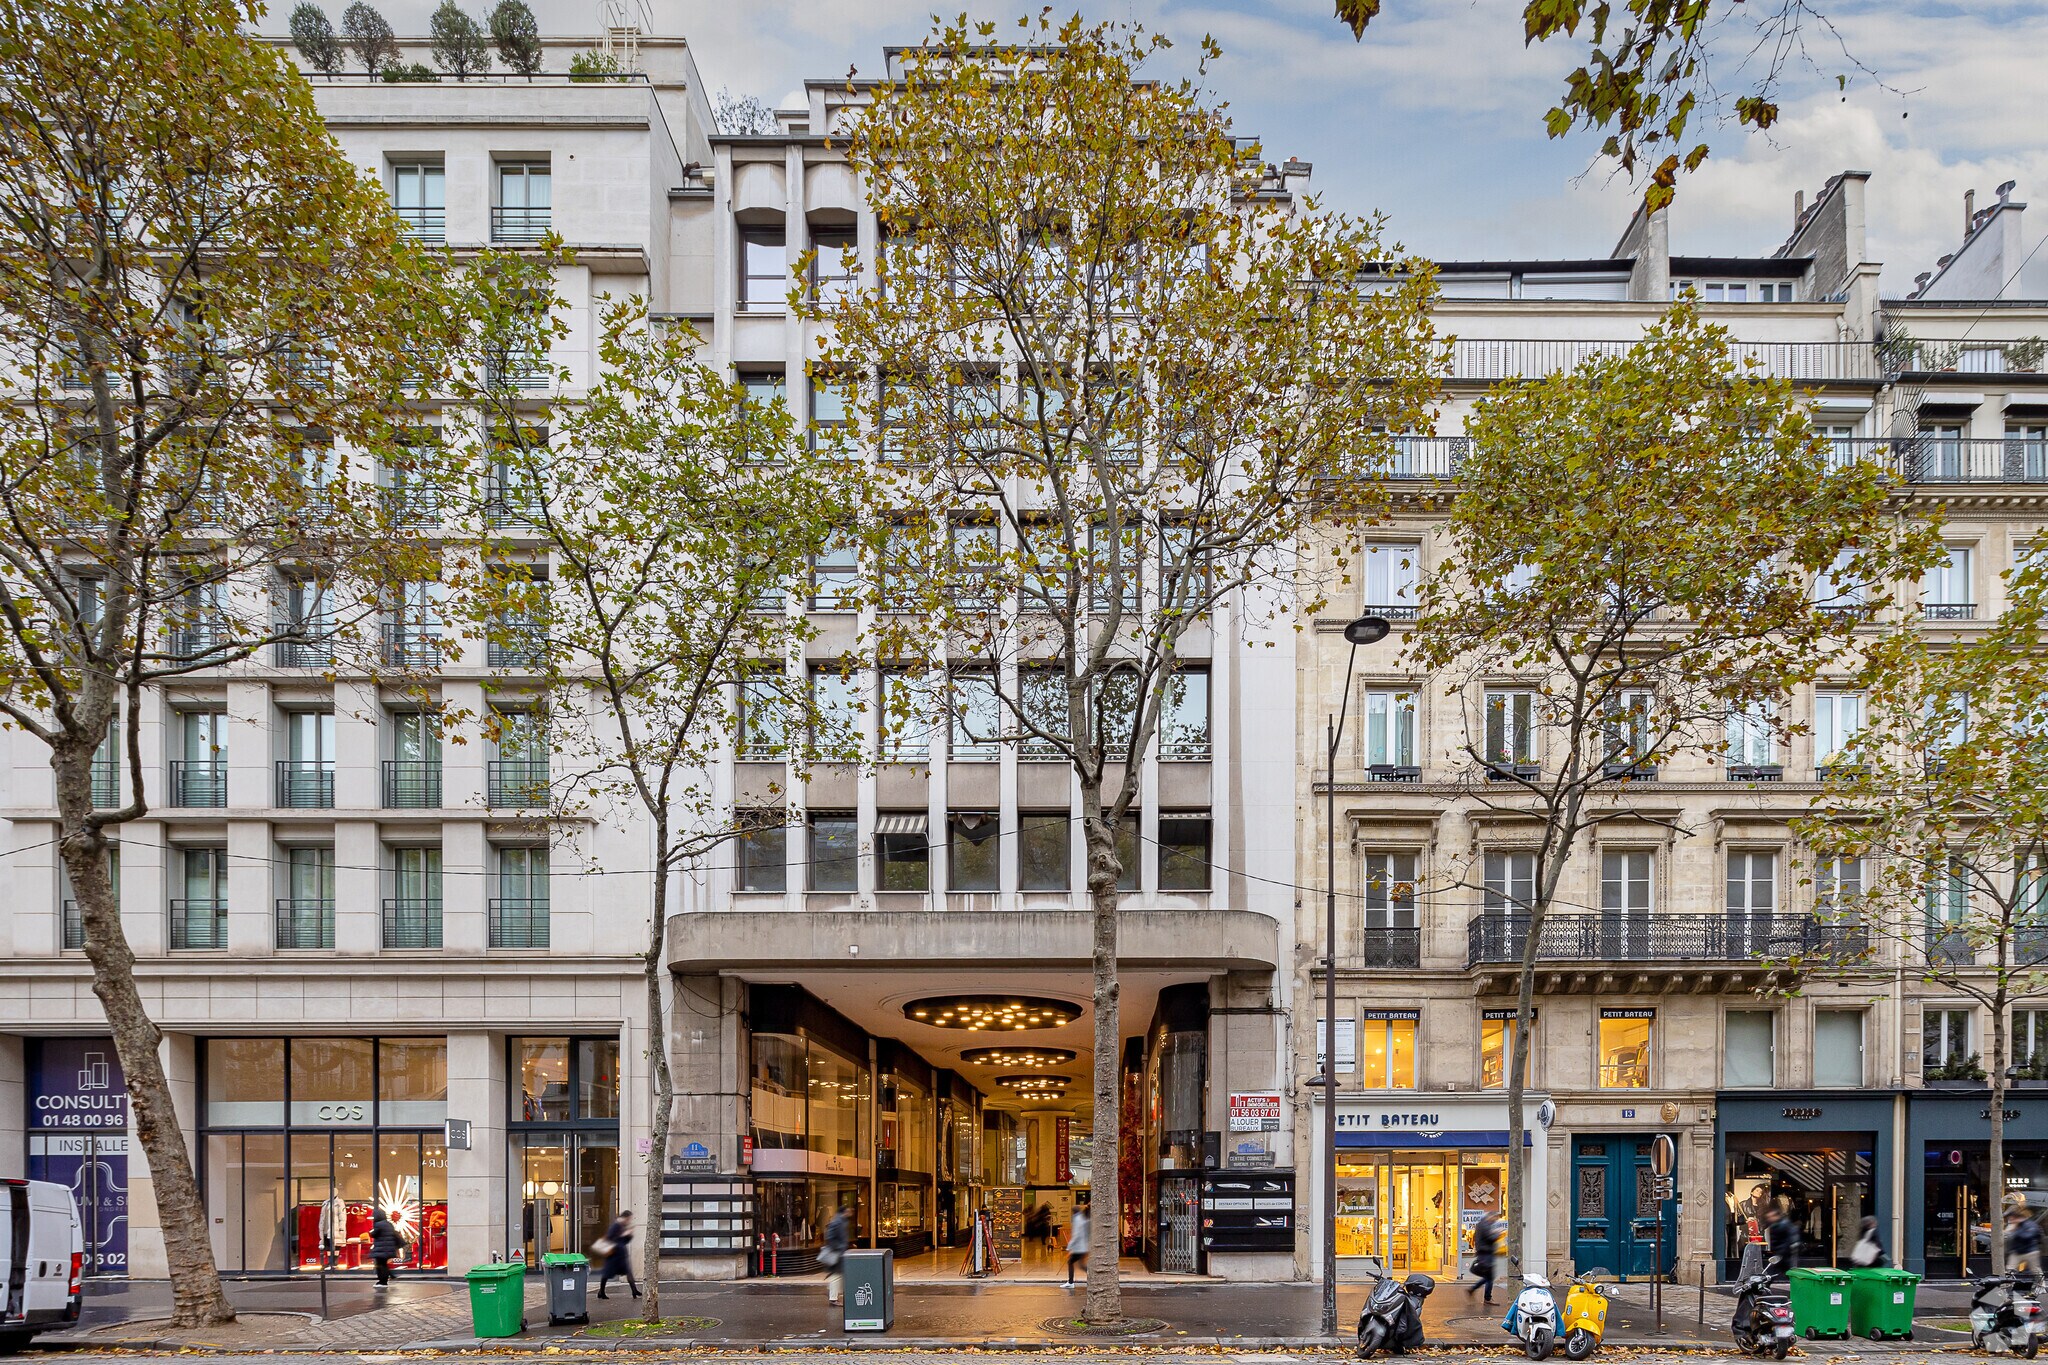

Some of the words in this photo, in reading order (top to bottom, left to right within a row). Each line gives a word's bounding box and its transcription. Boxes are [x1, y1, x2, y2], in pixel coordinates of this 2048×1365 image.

[318, 1105, 364, 1120] COS
[1231, 1108, 1240, 1117] 01
[1240, 1108, 1250, 1117] 56
[1250, 1108, 1260, 1117] 03
[1260, 1108, 1270, 1117] 97
[1270, 1108, 1280, 1117] 07
[42, 1114, 59, 1126] 01
[61, 1114, 81, 1126] 48
[83, 1114, 102, 1126] 00
[104, 1113, 124, 1126] 96
[1236, 1118, 1259, 1126] LOUER
[1335, 1114, 1370, 1126] ETIT
[1381, 1114, 1439, 1126] BATEAU
[450, 1129, 467, 1140] COS
[1058, 1119, 1067, 1180] REAUX
[107, 1253, 126, 1265] 02
